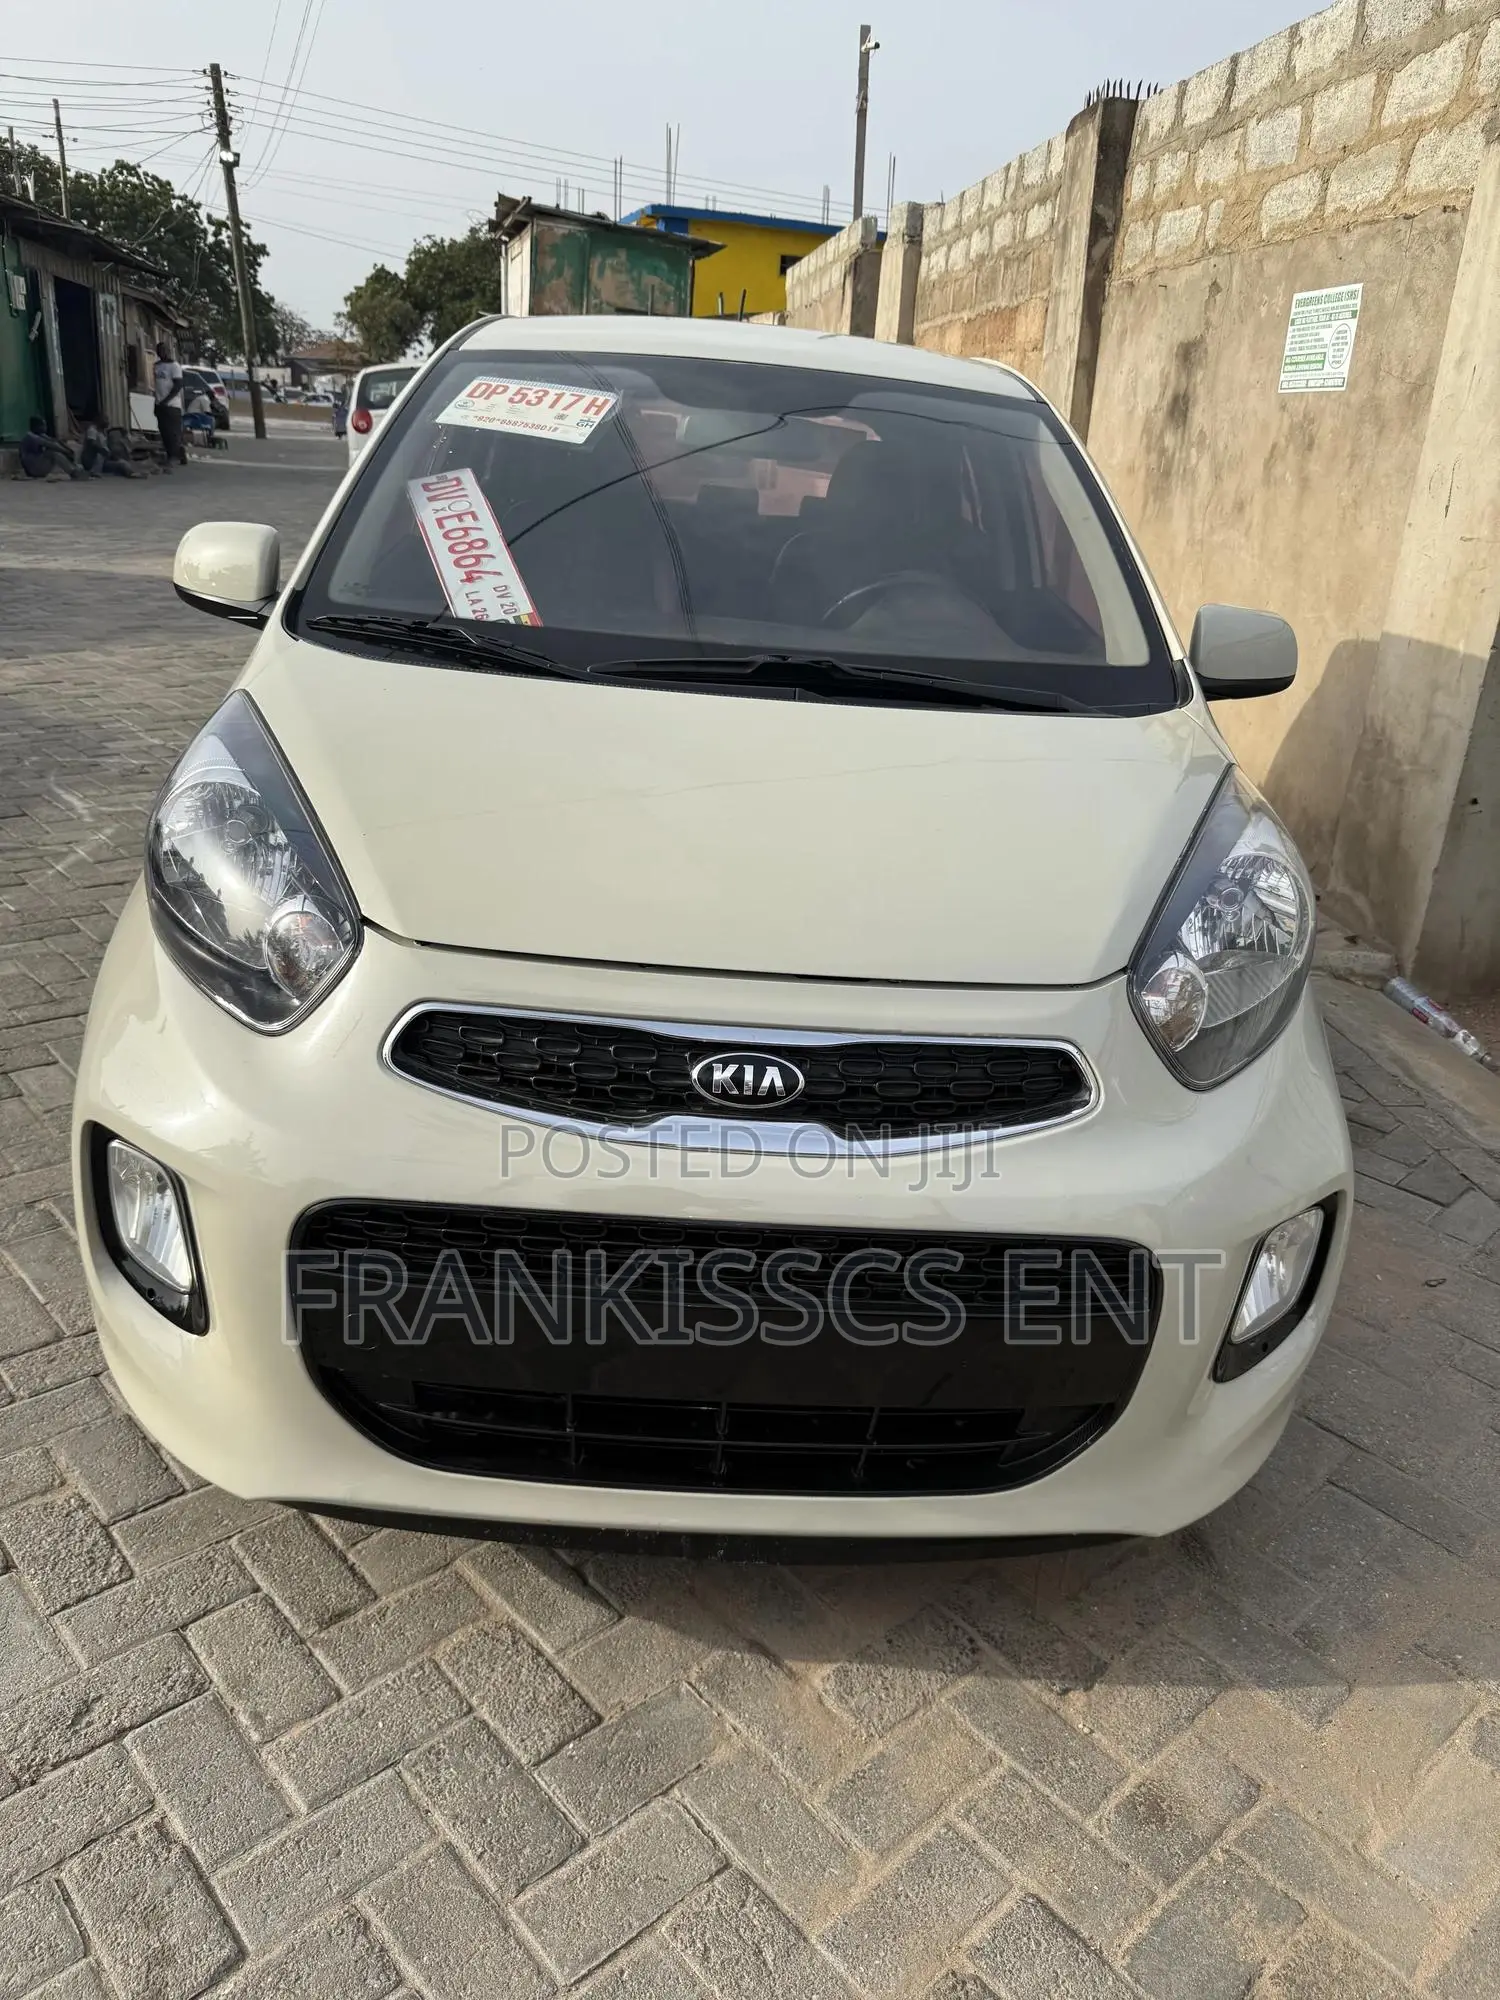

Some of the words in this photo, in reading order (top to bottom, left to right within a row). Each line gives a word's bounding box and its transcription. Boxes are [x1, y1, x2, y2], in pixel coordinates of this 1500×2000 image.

[466, 382, 509, 401] DP
[507, 387, 586, 412] 5317
[582, 397, 611, 417] H
[465, 591, 484, 606] LA
[493, 585, 514, 599] DV
[500, 602, 518, 615] 20
[711, 1063, 786, 1097] KIA
